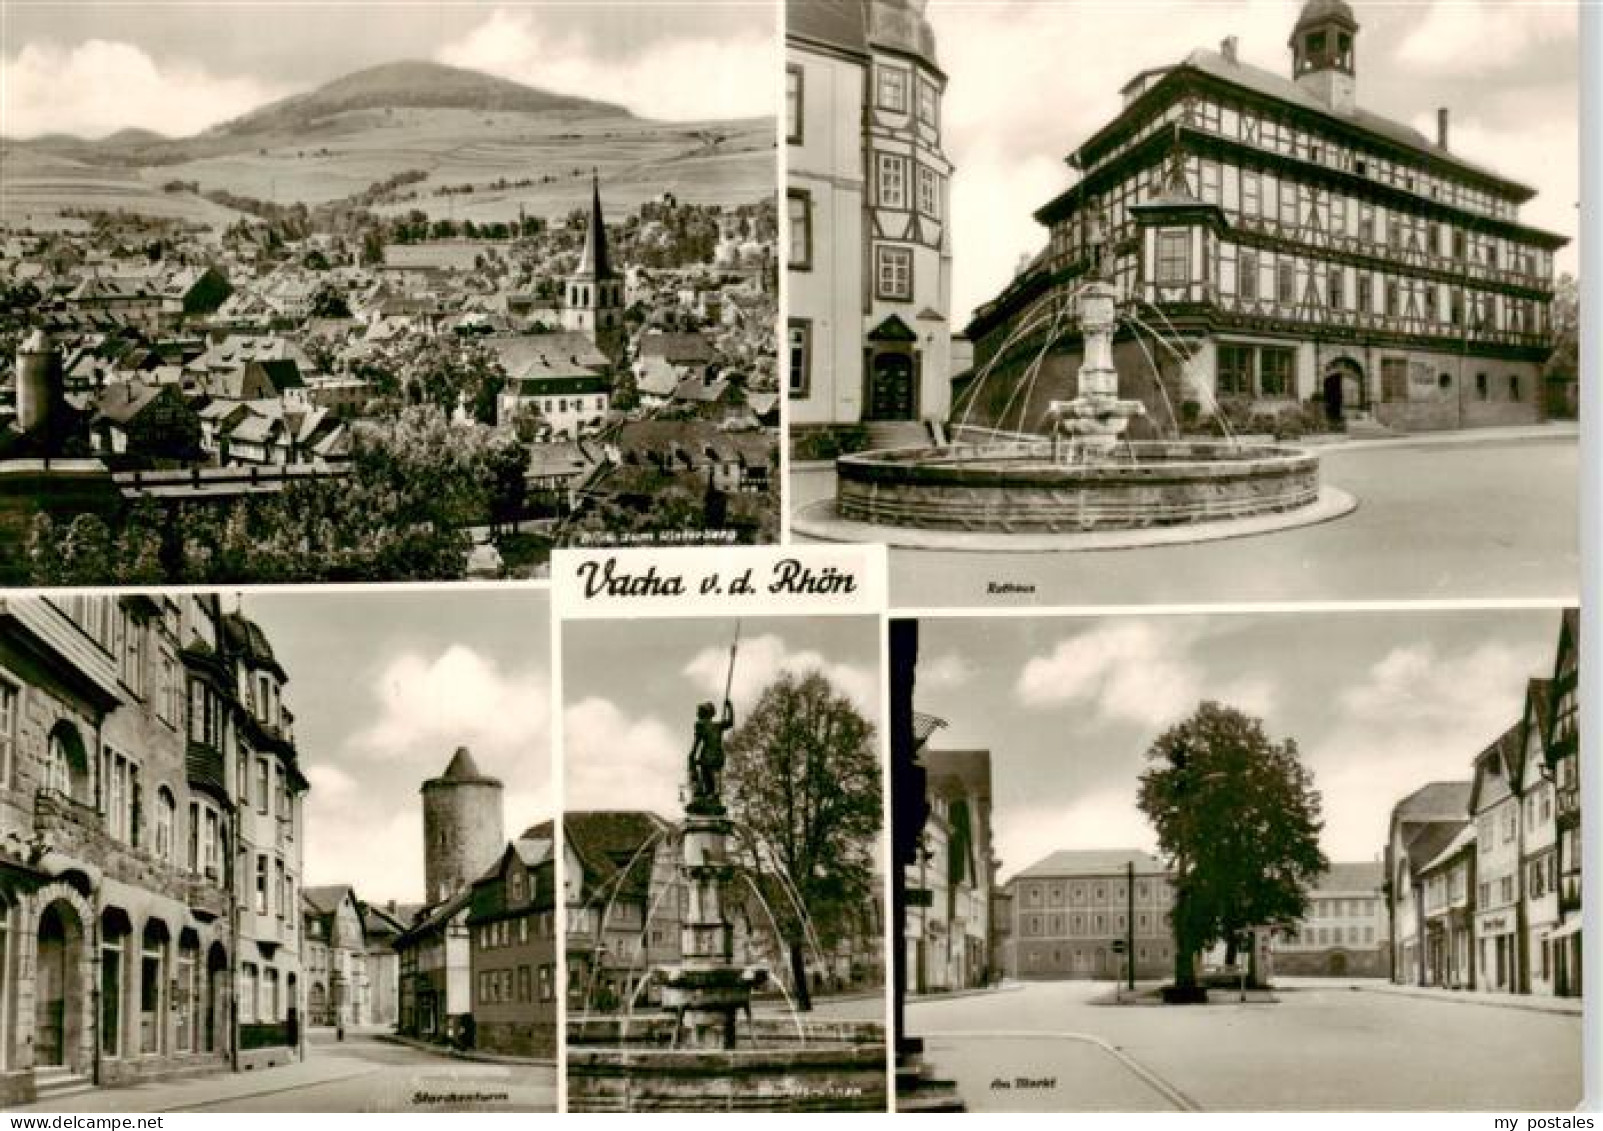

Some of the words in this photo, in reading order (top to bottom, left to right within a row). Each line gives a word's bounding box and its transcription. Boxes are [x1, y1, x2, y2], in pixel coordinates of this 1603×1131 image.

[576, 556, 687, 599] Vacha
[699, 573, 722, 595] v.
[728, 568, 756, 596] d.
[767, 558, 857, 595] Rhön
[1016, 1076, 1057, 1090] Markt
